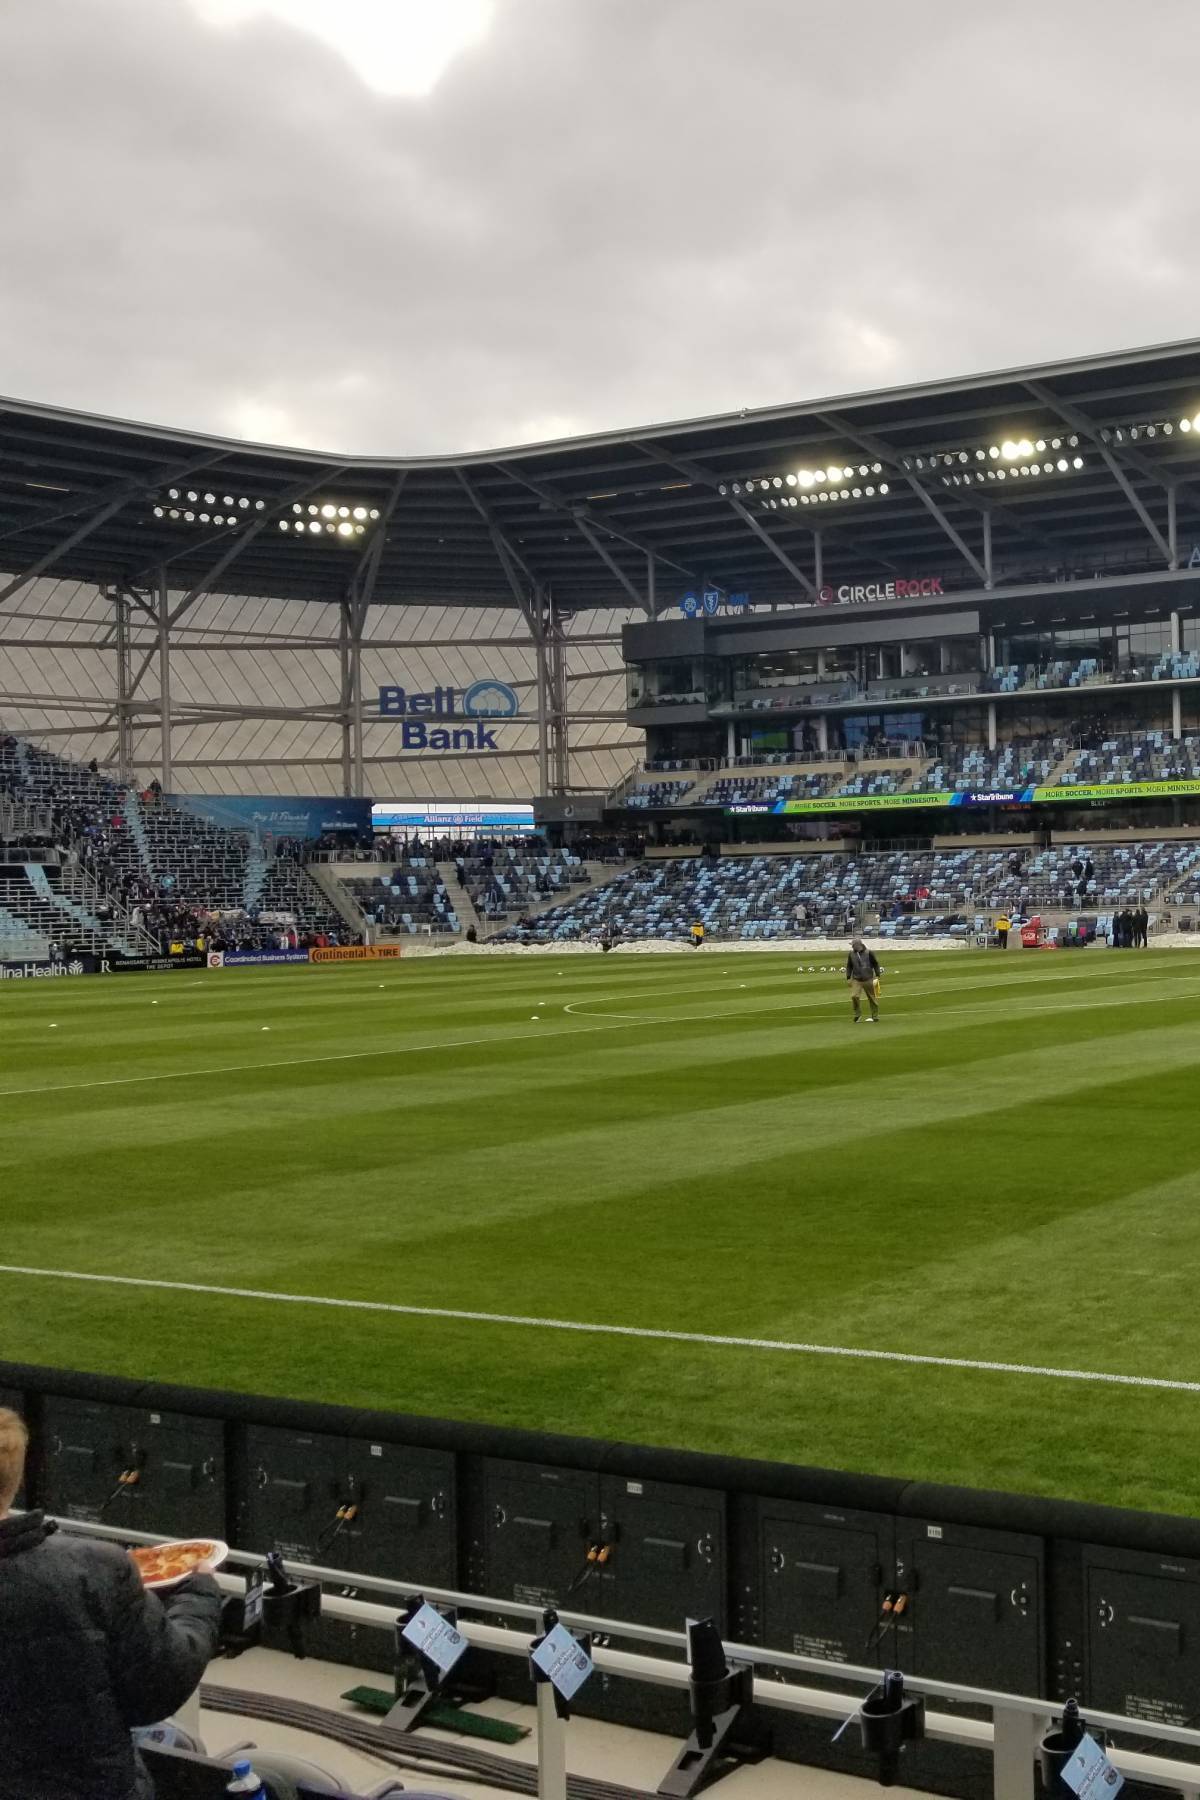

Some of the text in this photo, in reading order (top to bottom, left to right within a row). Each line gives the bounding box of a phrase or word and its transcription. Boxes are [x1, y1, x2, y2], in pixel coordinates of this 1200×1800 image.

[838, 578, 943, 603] CIRCLEROCK
[379, 686, 454, 715] Bell
[402, 721, 498, 749] Bank
[977, 793, 1013, 801] StarTribune
[424, 815, 483, 823] Allianz Field
[312, 948, 399, 963] Continental TIRE
[24, 961, 67, 978] Health
